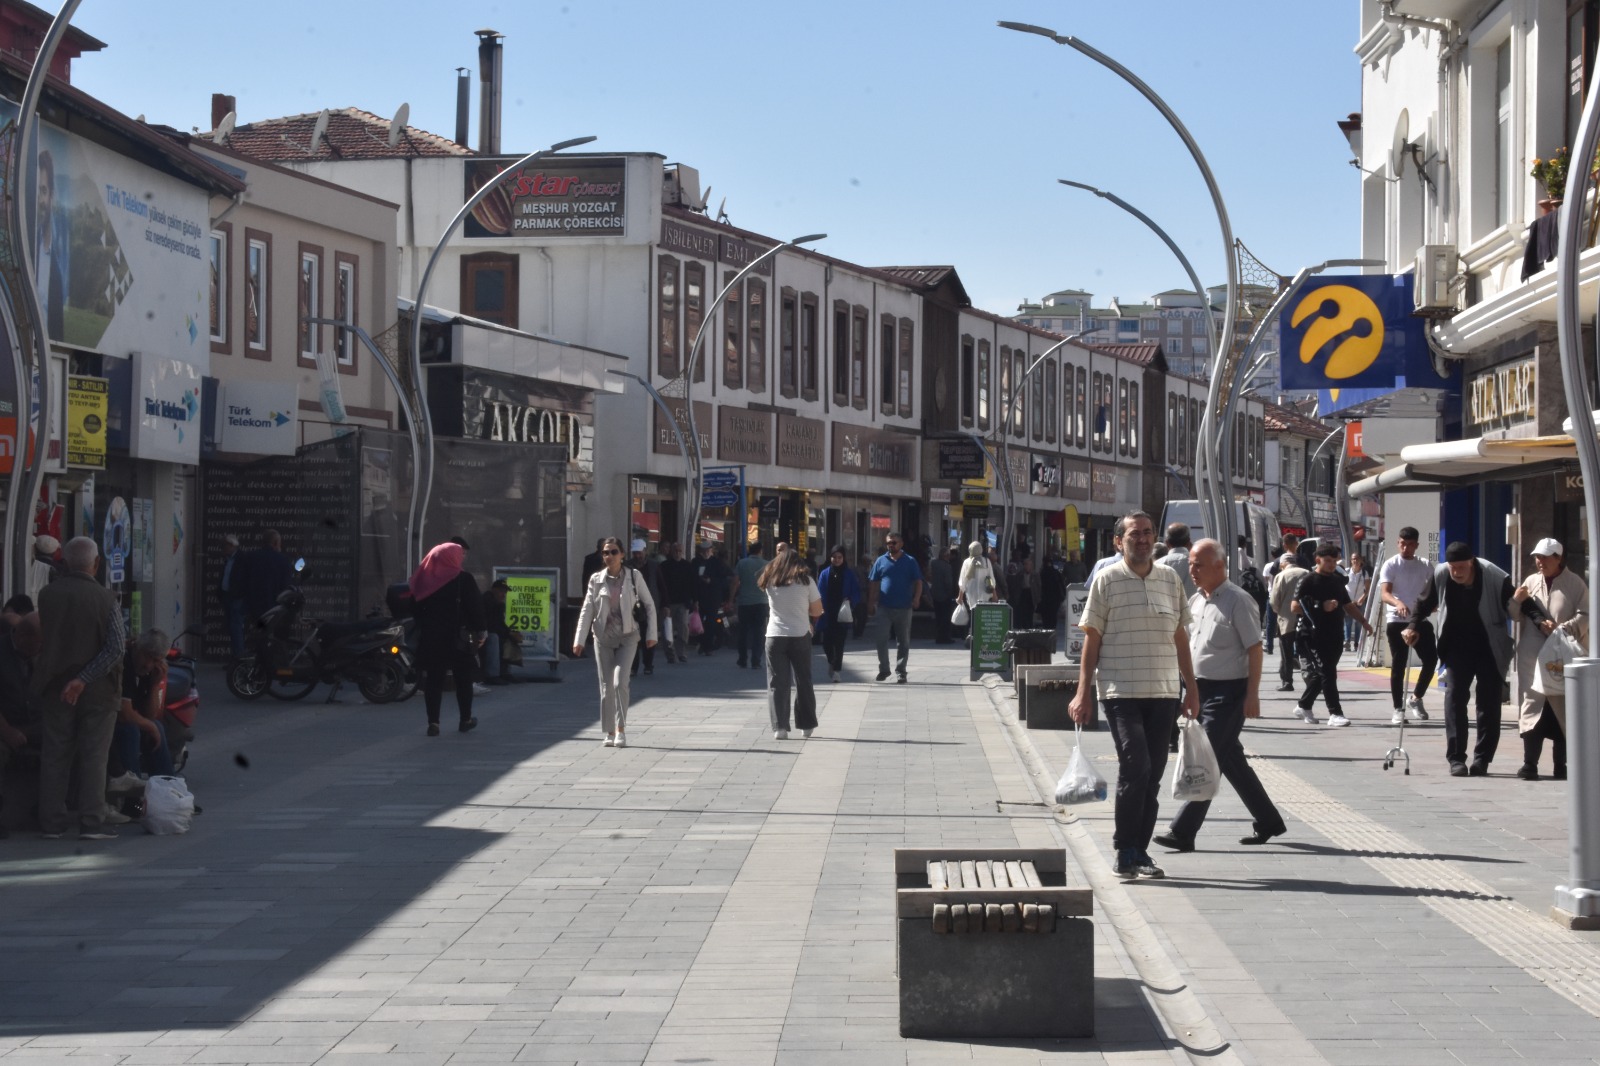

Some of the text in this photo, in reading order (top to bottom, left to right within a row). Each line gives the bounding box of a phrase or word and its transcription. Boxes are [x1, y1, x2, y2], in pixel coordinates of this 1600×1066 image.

[513, 173, 580, 197] star
[106, 184, 121, 208] Türk
[121, 190, 148, 218] Telekom
[522, 202, 617, 216] MEŞHUR YOZGAT
[514, 214, 624, 231] PARMAK ÇÖREKCİSİ
[664, 223, 714, 255] İŞBİLENLER
[144, 397, 186, 421] Türk Telekom
[228, 405, 252, 416] Türk
[228, 416, 272, 428] Telekom
[524, 585, 547, 593] FIRSAT
[509, 614, 541, 630] 299
